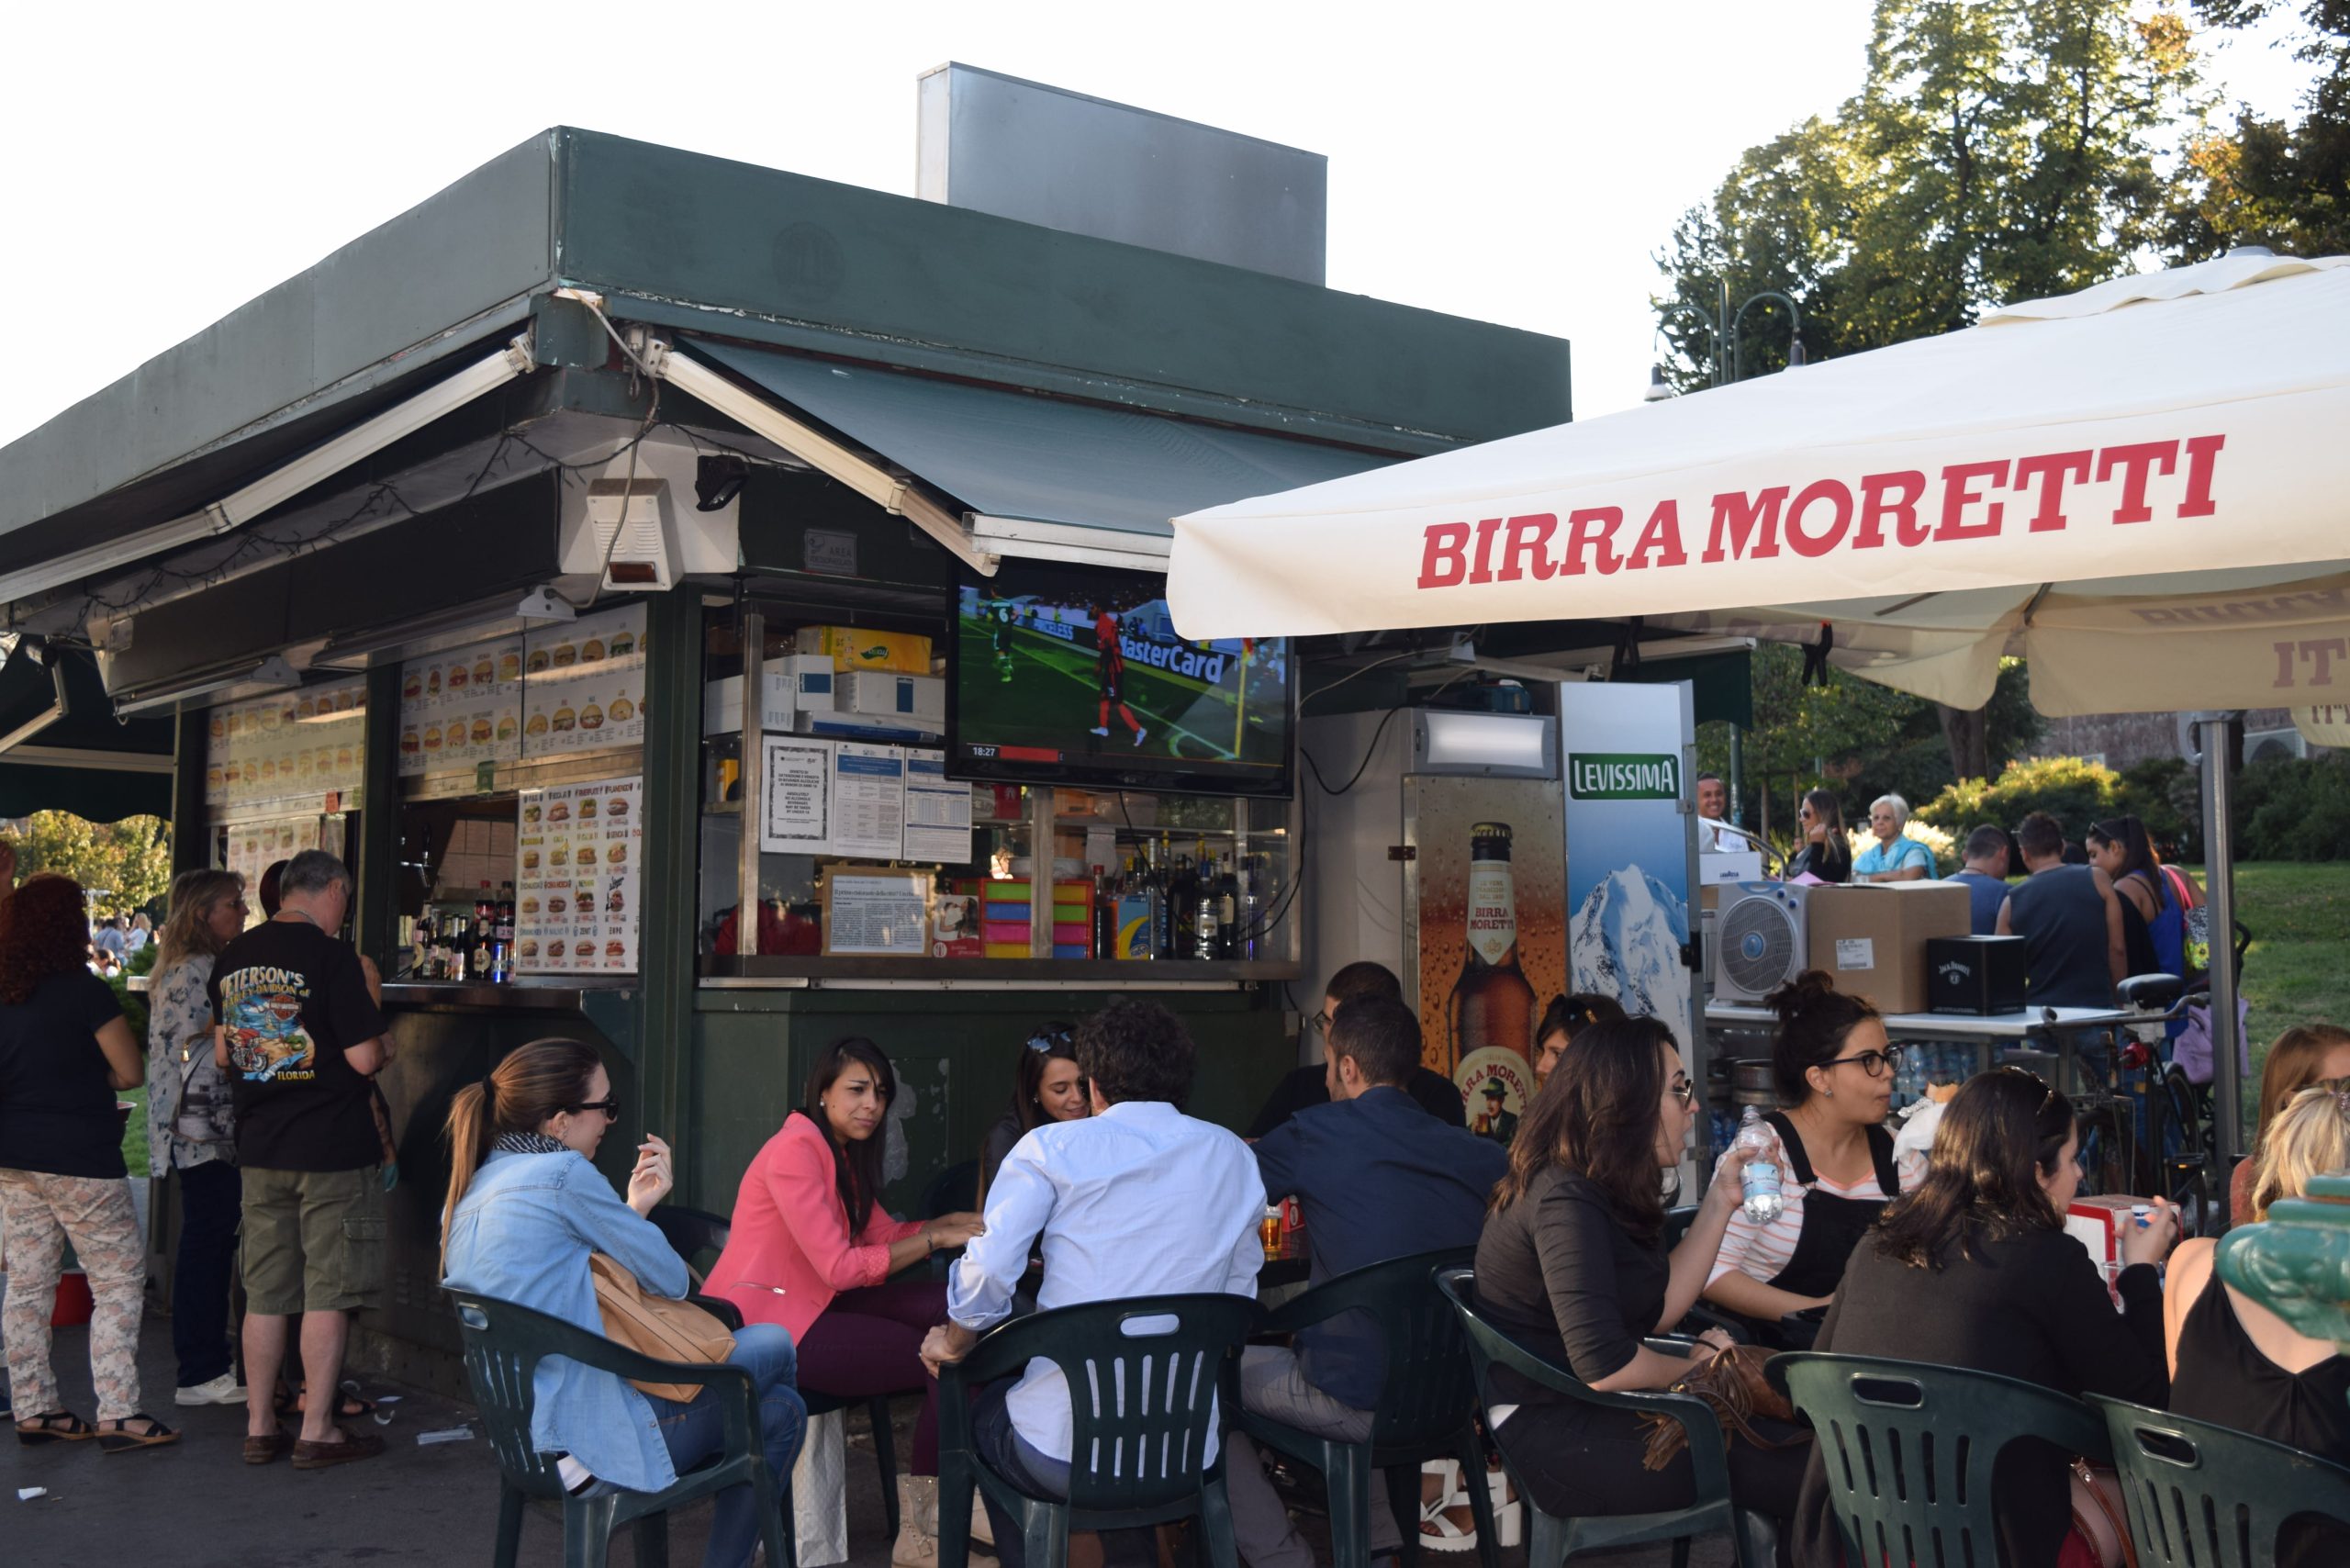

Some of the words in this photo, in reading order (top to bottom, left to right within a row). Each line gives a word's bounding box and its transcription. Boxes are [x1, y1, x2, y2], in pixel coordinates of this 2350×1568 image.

[1416, 500, 1687, 589] BIRRA
[1701, 433, 2226, 563] MORETTI
[829, 546, 853, 559] AREA
[999, 608, 1009, 623] 6
[972, 746, 996, 757] 18:27
[1573, 759, 1675, 792] LEVISSIMA
[1475, 907, 1509, 918] BIRRA
[1470, 919, 1515, 930] MORETTI
[277, 1070, 315, 1081] FLORIDA
